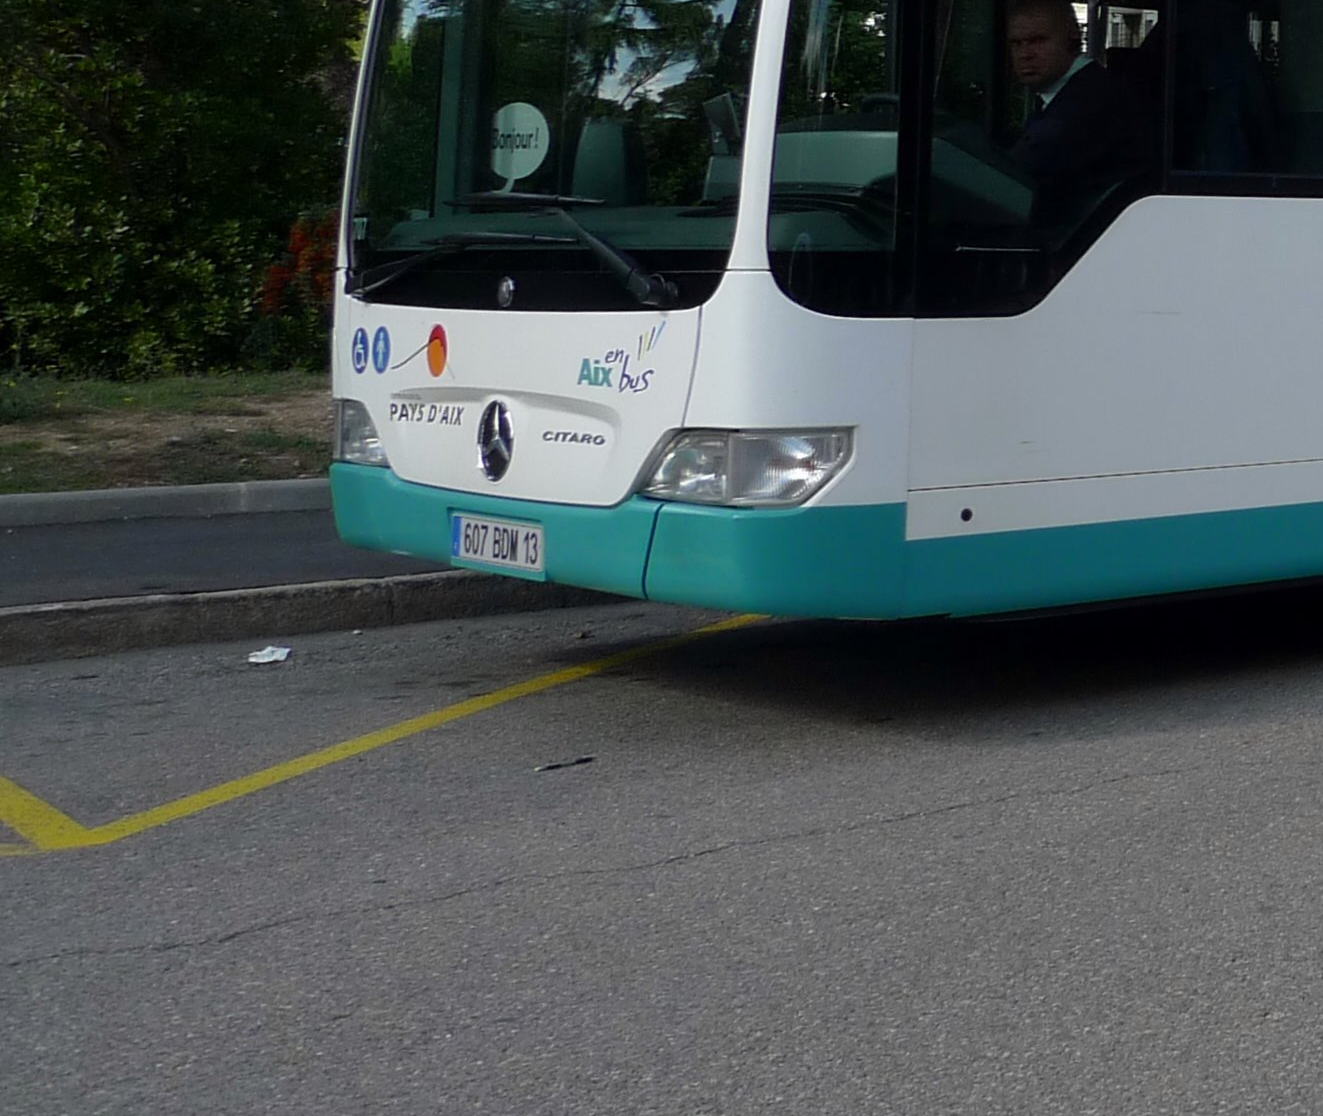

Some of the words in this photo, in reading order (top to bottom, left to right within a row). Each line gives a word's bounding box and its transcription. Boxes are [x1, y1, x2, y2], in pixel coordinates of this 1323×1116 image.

[577, 358, 613, 388] Aix
[605, 348, 624, 364] en
[619, 354, 655, 393] bus
[390, 403, 426, 422] PAYS
[427, 404, 465, 426] D'AIX
[542, 431, 606, 446] CITARO
[464, 522, 489, 556] 607
[492, 527, 519, 562] BDM
[523, 532, 539, 565] 13
